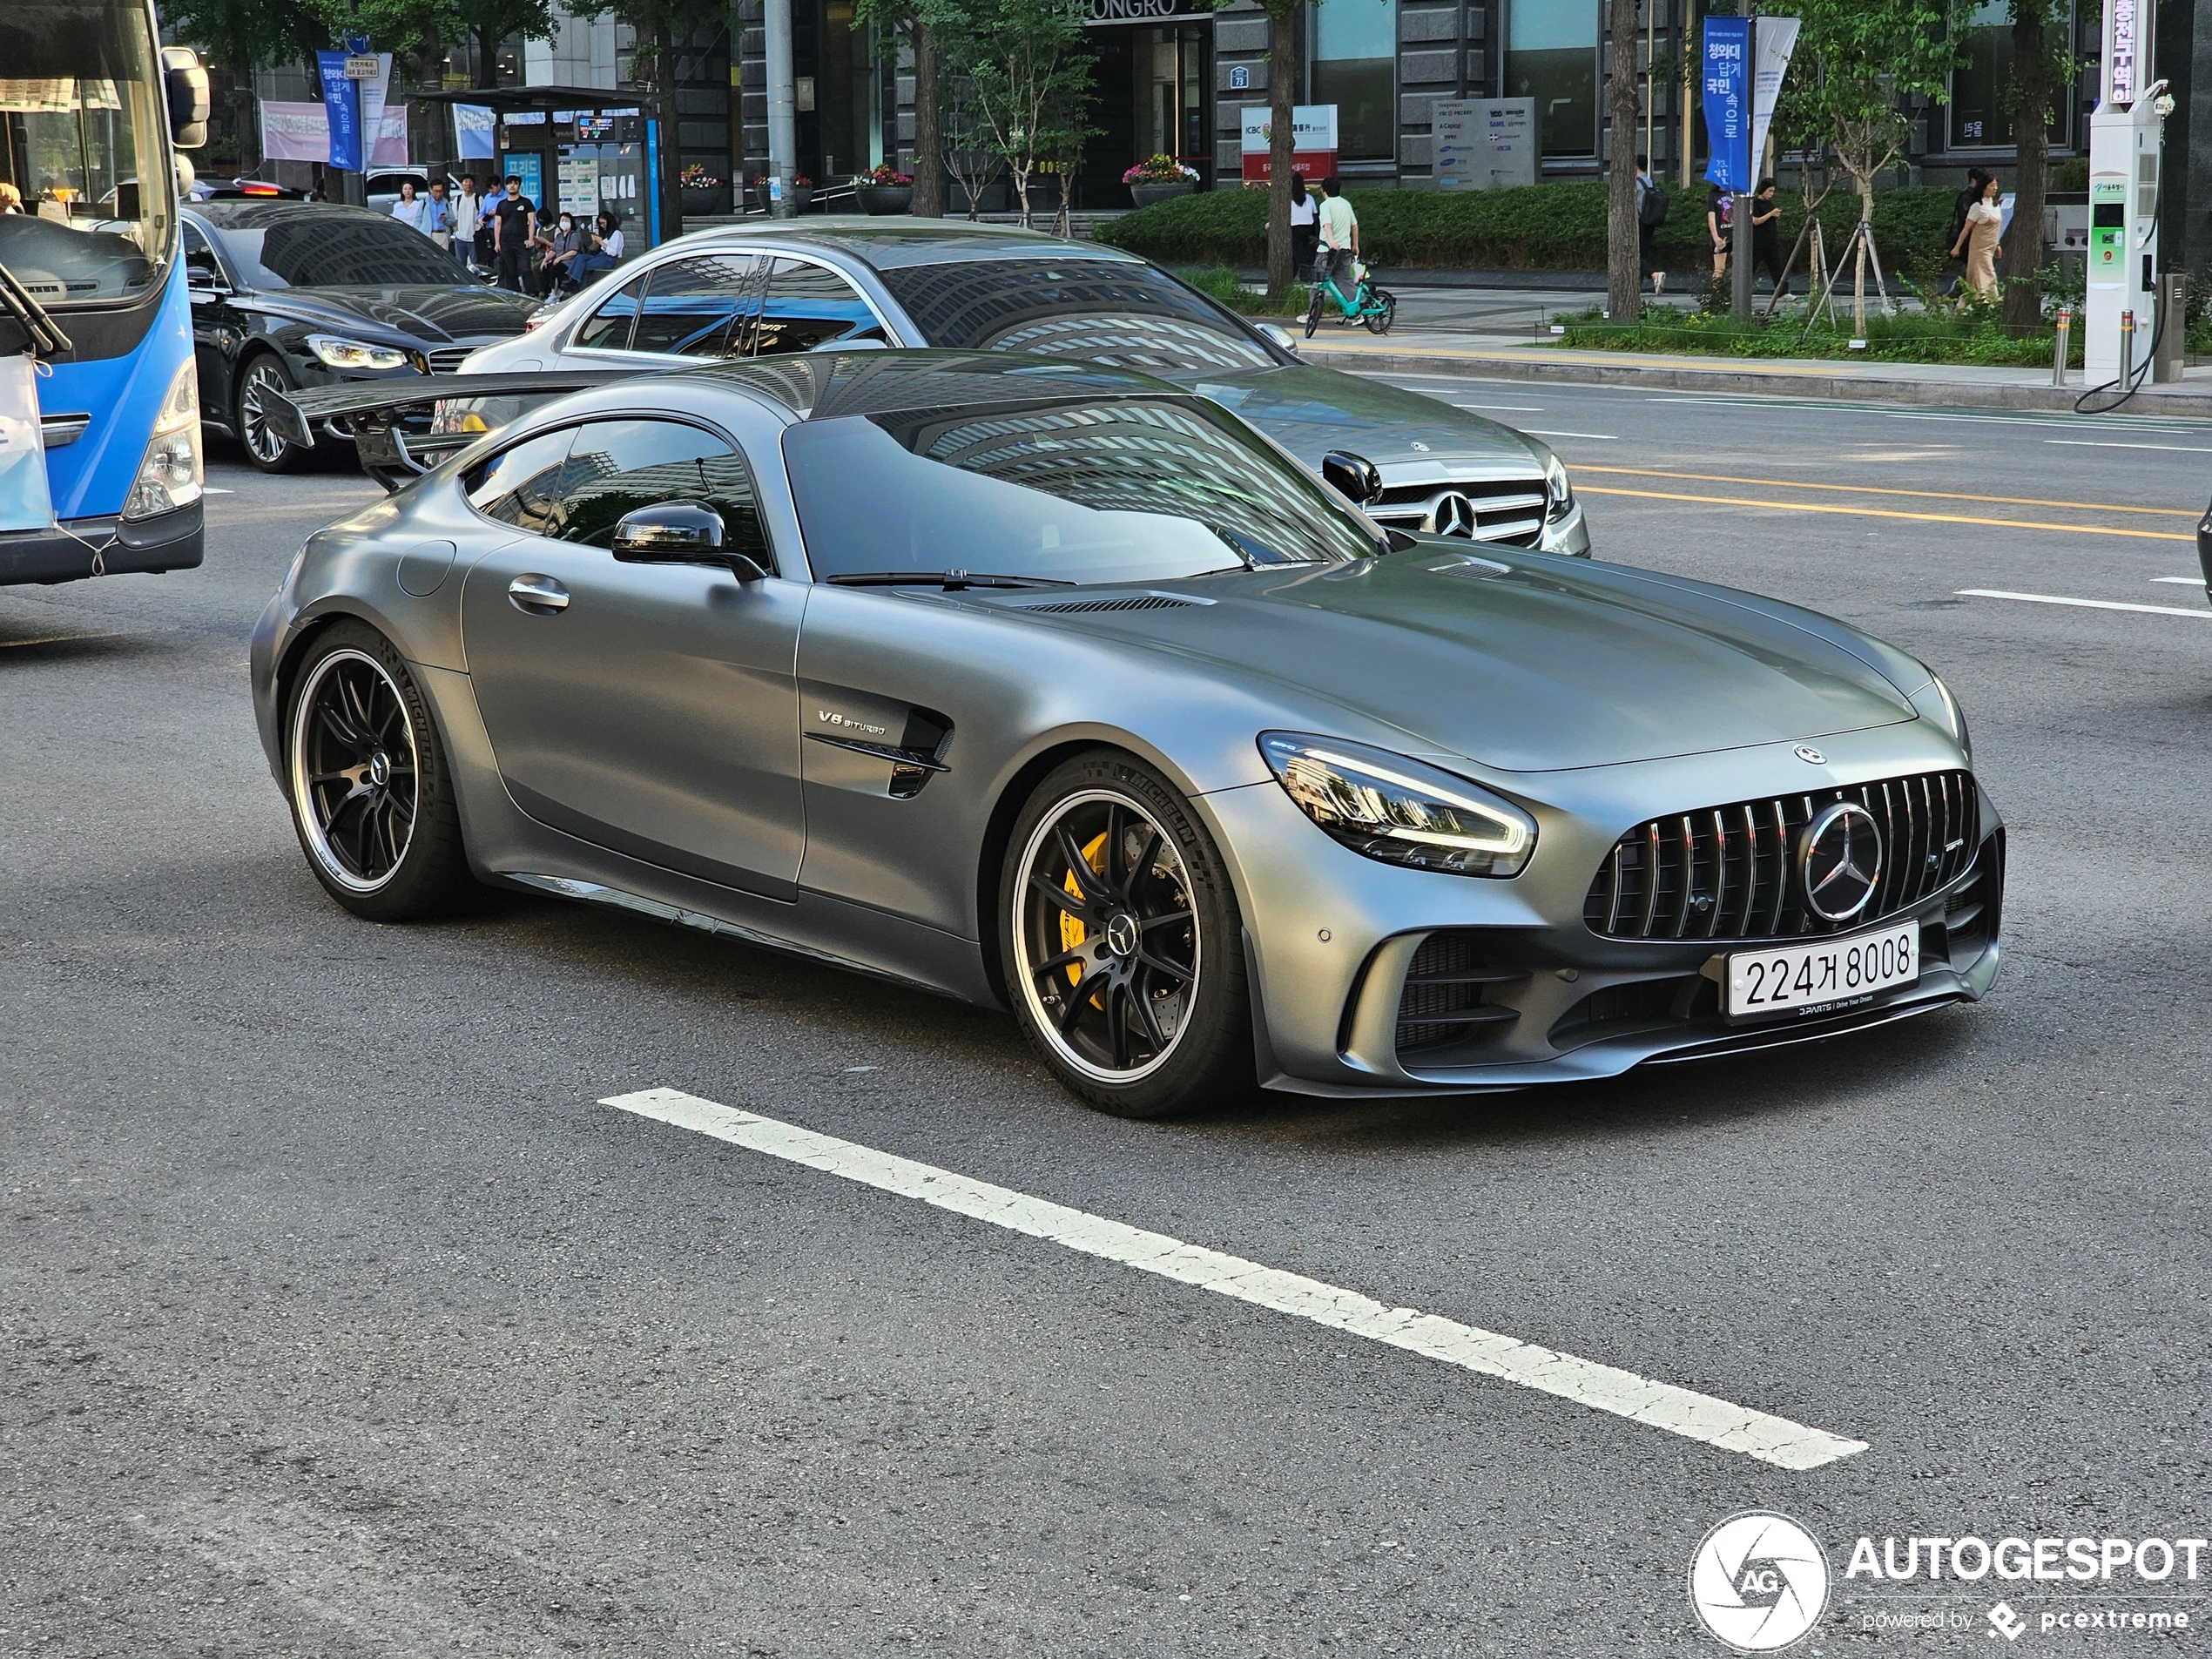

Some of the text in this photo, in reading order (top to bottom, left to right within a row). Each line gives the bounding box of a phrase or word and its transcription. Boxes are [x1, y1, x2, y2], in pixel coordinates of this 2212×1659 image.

[1708, 43, 1741, 60] 청와대
[1718, 61, 1741, 78] 답게
[332, 82, 350, 92] 답게
[1706, 78, 1730, 95] 국민
[340, 103, 351, 134] 속으로
[1724, 93, 1738, 138] 속으로
[509, 159, 538, 179] 프리드
[519, 180, 538, 196] 이프
[405, 685, 434, 774] MICHELIN
[819, 710, 886, 736] V8 BITURBO
[1130, 772, 1195, 843] MICHELIN
[1746, 934, 1910, 1005] 224거 8008
